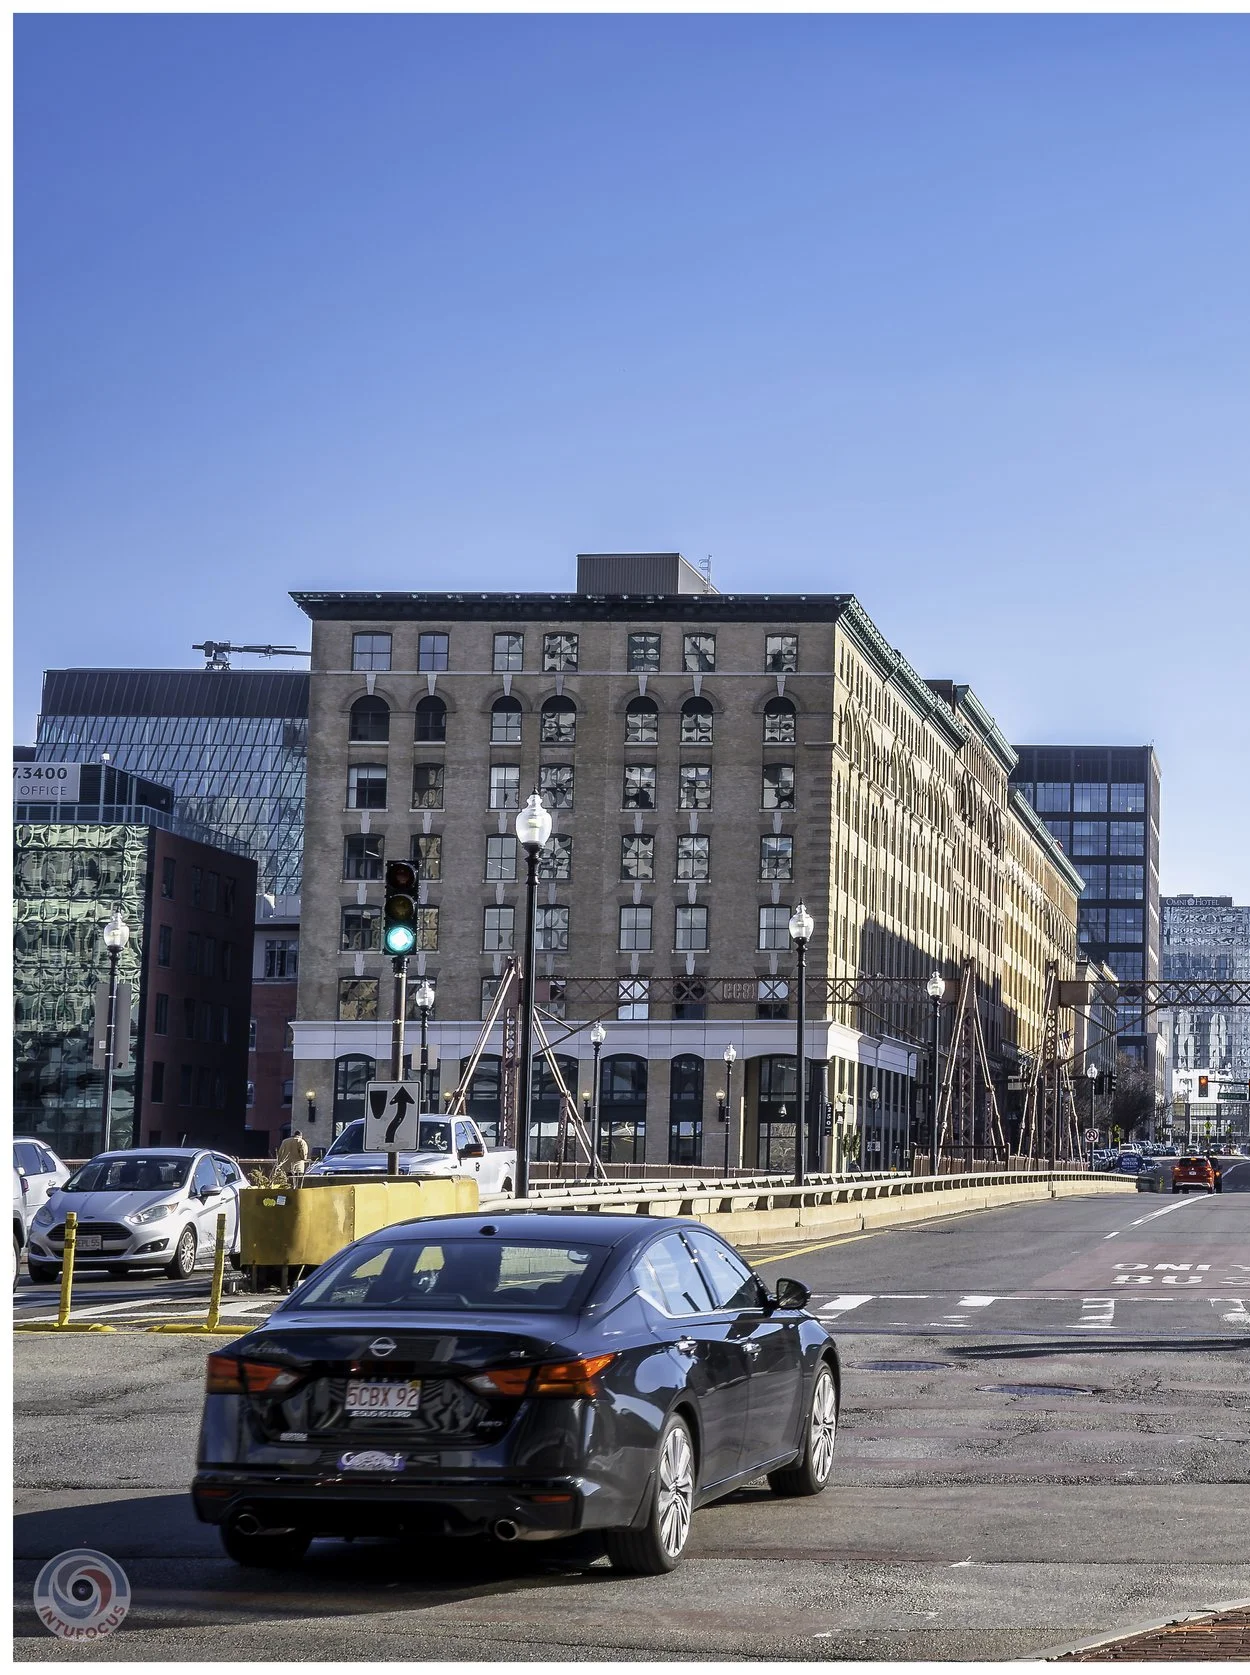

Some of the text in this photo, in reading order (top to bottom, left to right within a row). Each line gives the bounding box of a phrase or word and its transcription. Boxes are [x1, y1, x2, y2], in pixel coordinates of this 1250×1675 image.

[20, 785, 67, 796] OFFICE
[1166, 898, 1220, 906] OMNI HOTEL
[347, 1386, 418, 1408] 5CBX 92
